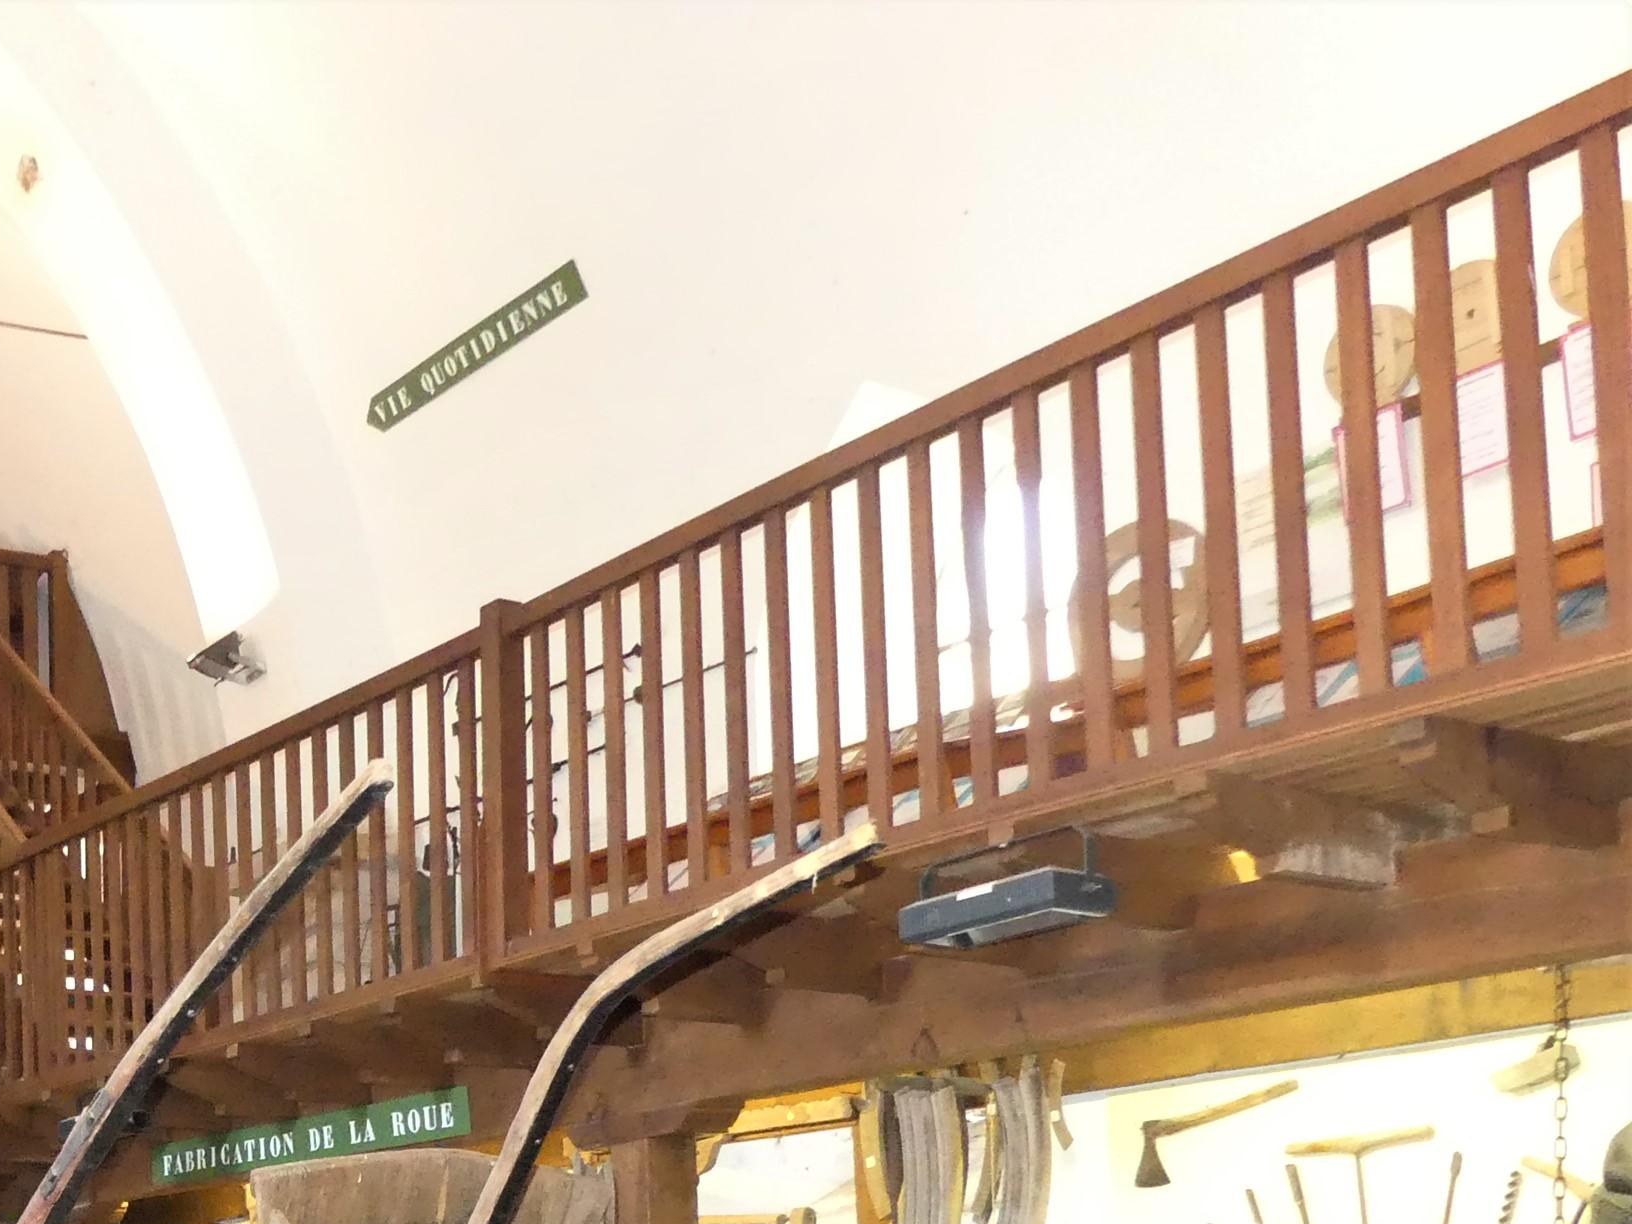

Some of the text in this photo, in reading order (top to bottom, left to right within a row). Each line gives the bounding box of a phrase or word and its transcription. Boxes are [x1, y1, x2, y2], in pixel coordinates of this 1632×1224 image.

[374, 280, 568, 423] VIE QUOTIDIENNE
[162, 1102, 454, 1176] FABRICATION DE LA ROUE
